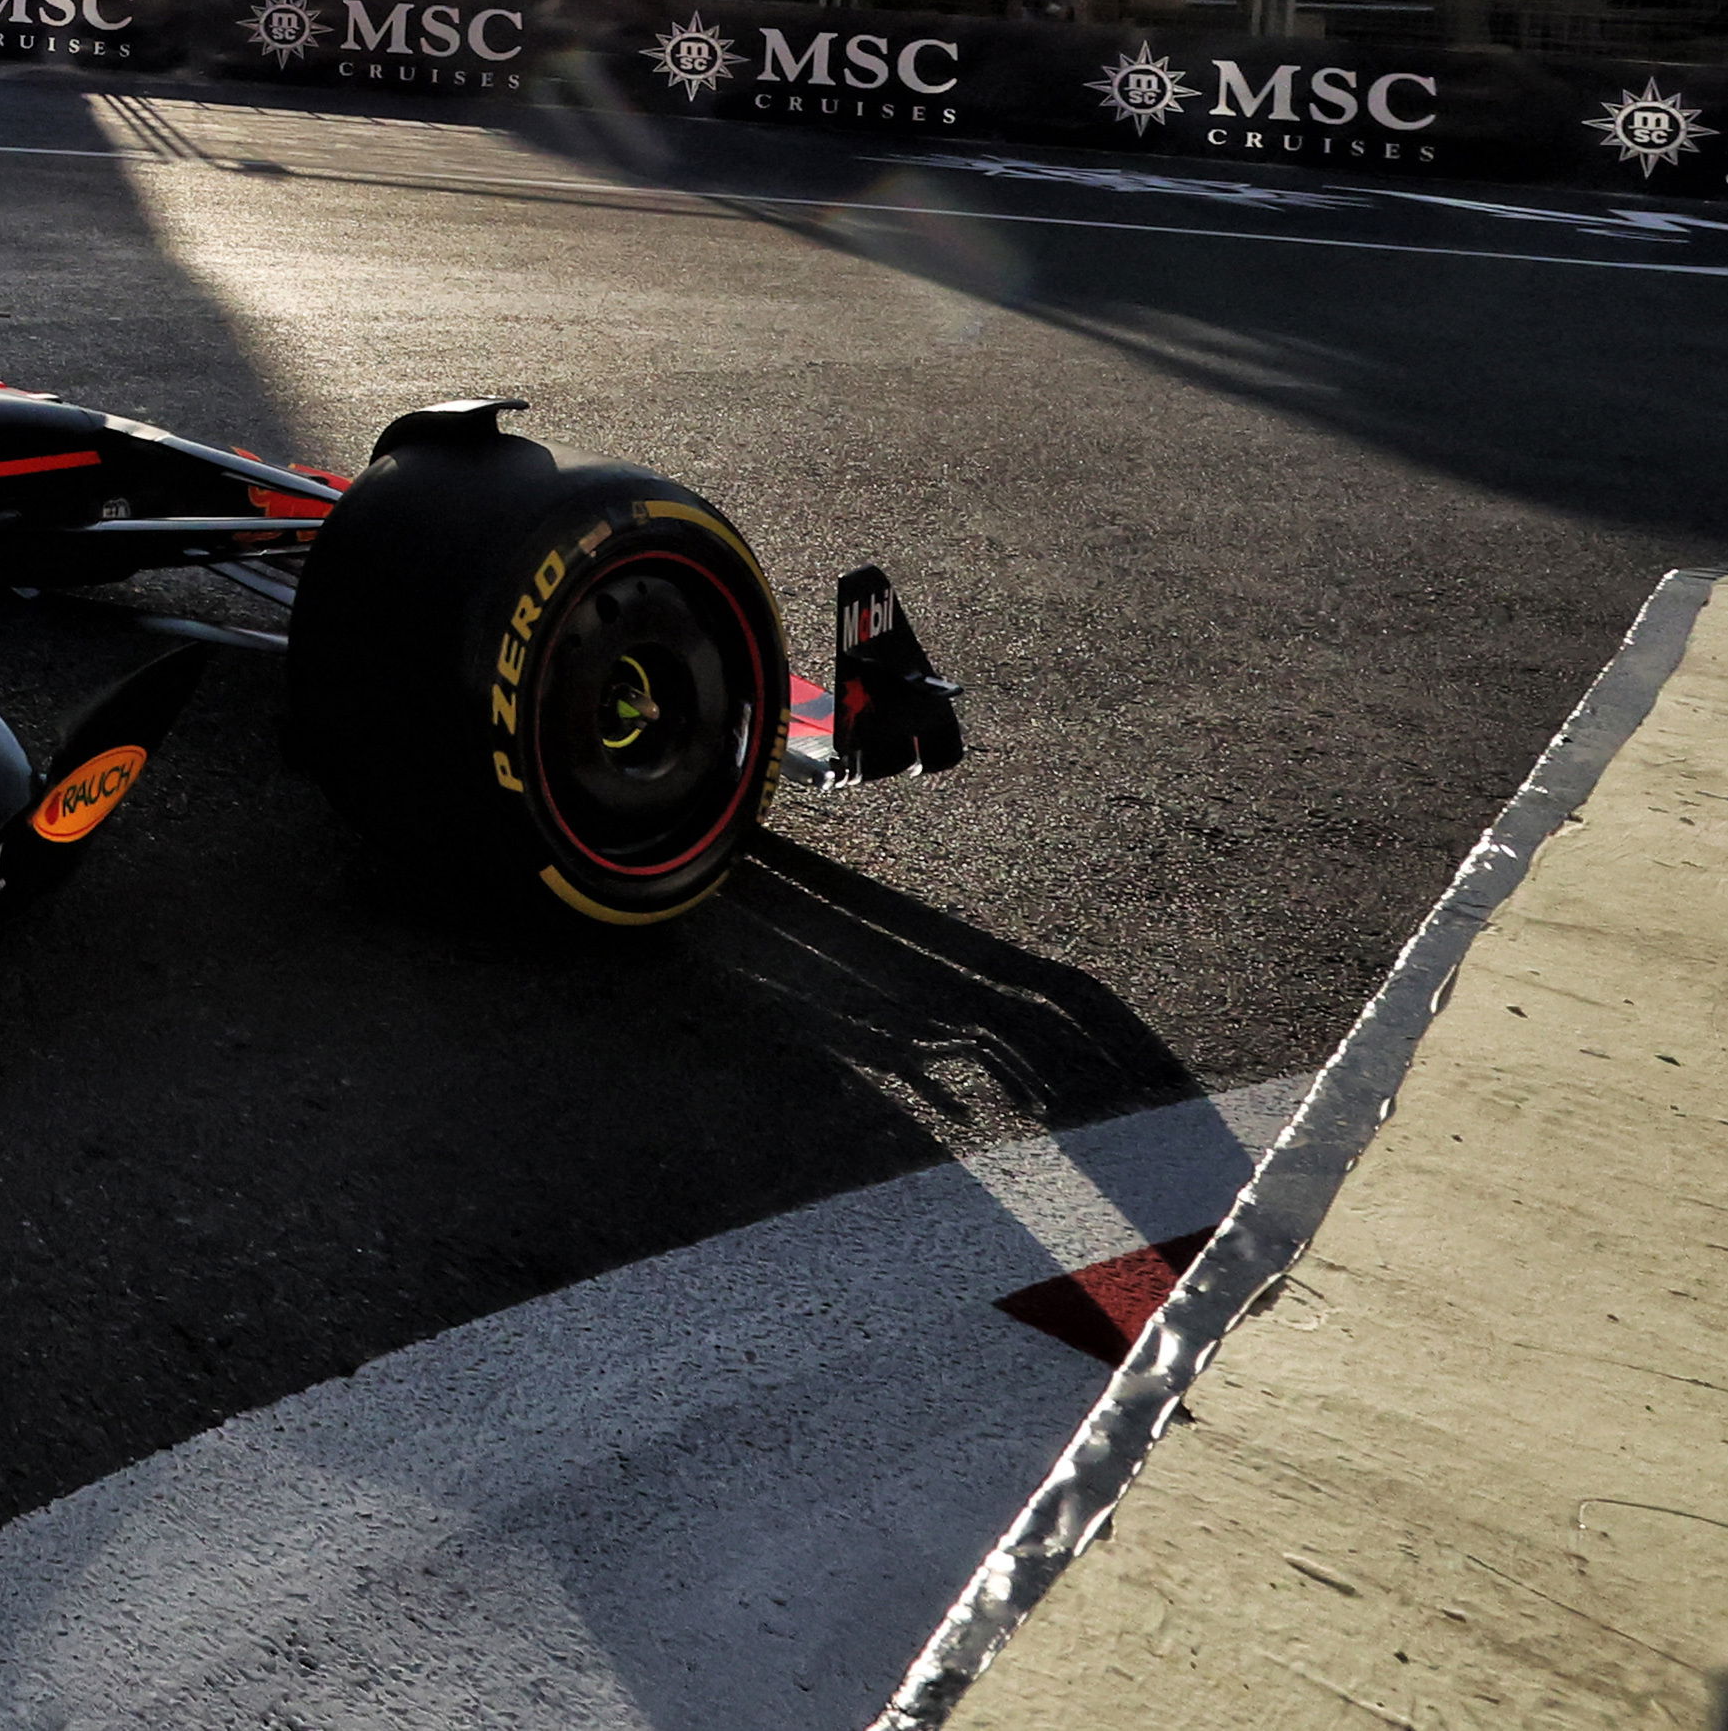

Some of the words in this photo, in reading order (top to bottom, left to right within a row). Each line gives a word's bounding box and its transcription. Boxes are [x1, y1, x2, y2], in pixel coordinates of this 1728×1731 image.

[340, 0, 522, 61] MSC
[339, 62, 520, 90] CRUISES
[757, 28, 958, 94] MSC
[755, 94, 956, 124] CRUISES
[1208, 59, 1437, 130] MSC
[1207, 129, 1435, 162] CRUISES
[491, 549, 567, 736] ZERO
[844, 588, 893, 652] Mobil
[62, 761, 134, 818] RAUCH
[493, 751, 525, 793] P
